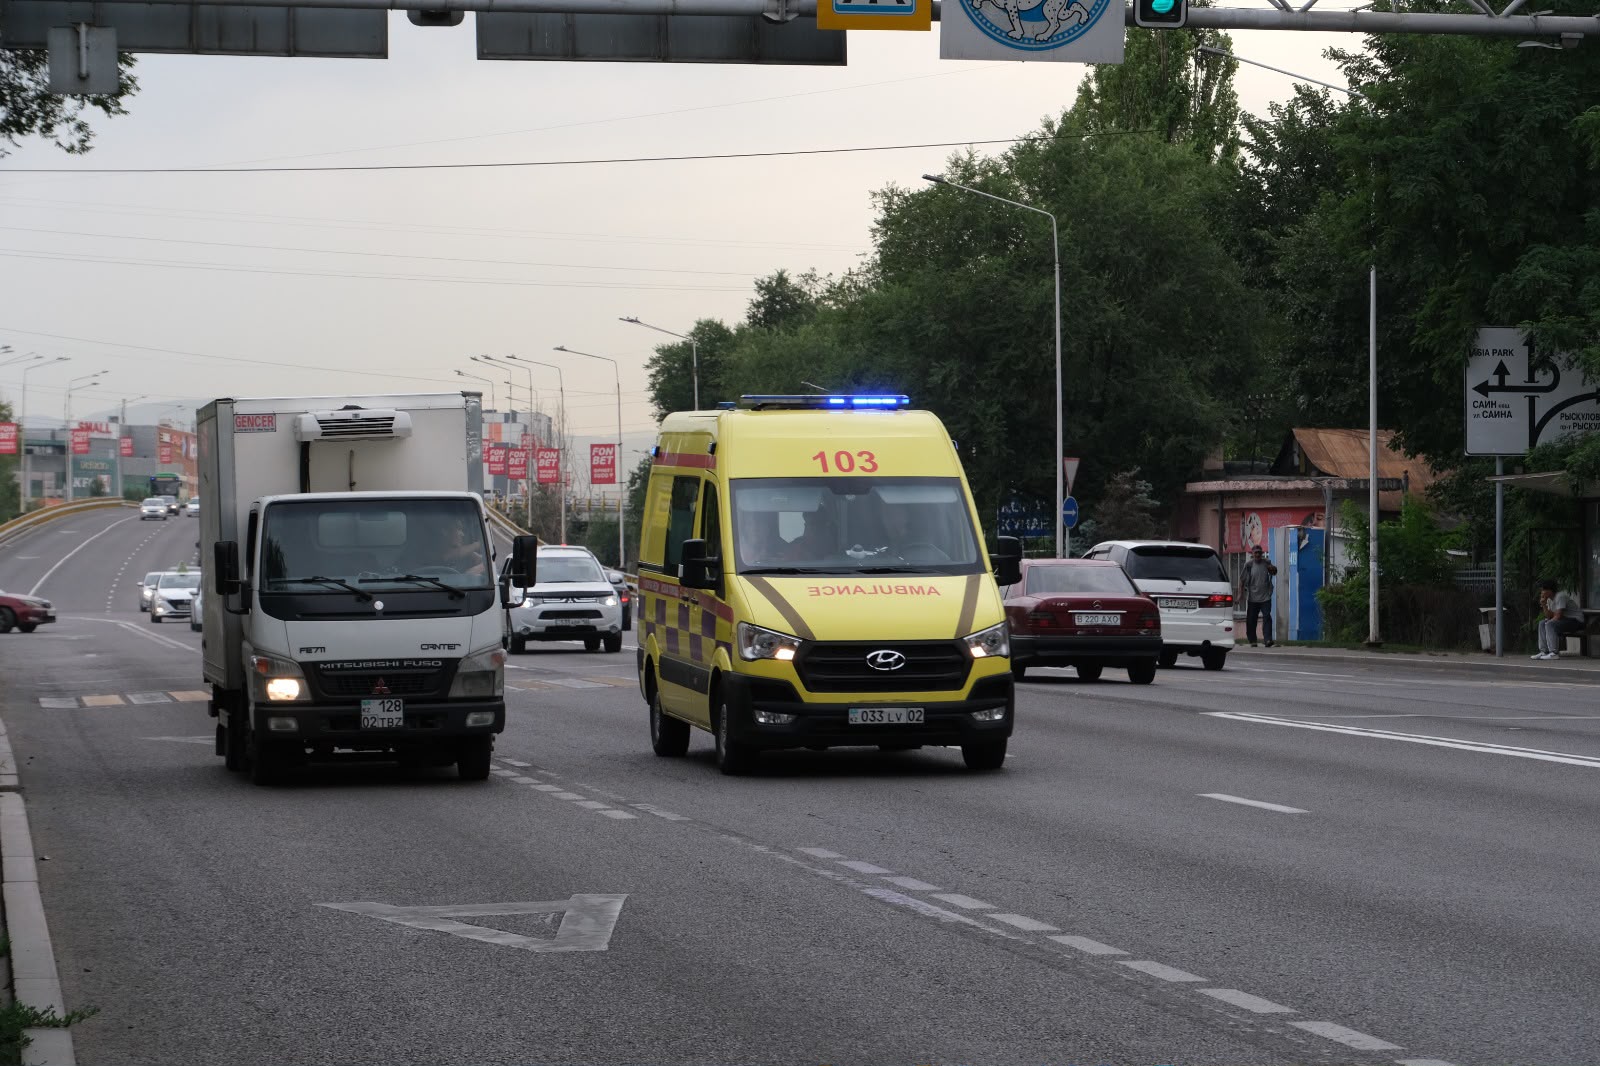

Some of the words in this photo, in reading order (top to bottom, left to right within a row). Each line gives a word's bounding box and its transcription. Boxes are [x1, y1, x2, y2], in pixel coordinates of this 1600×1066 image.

[1492, 348, 1515, 357] PARK
[1472, 400, 1497, 409] САИН
[1482, 410, 1513, 419] САИНА
[235, 415, 275, 428] GENCER
[79, 420, 113, 434] SMALL
[538, 451, 558, 459] FON
[592, 447, 614, 456] FON
[508, 457, 526, 465] BET
[538, 458, 558, 467] BET
[592, 455, 614, 465] BET
[812, 450, 879, 474] 103
[1076, 615, 1083, 623] B
[1085, 615, 1100, 624] 220
[420, 643, 462, 651] CANTER
[319, 661, 400, 669] MITSUBISHI
[378, 700, 402, 713] 128
[861, 710, 885, 723] 033
[887, 712, 903, 723] LV
[908, 709, 923, 722] 02
[362, 716, 377, 728] 02
[378, 717, 403, 728] TBZ
